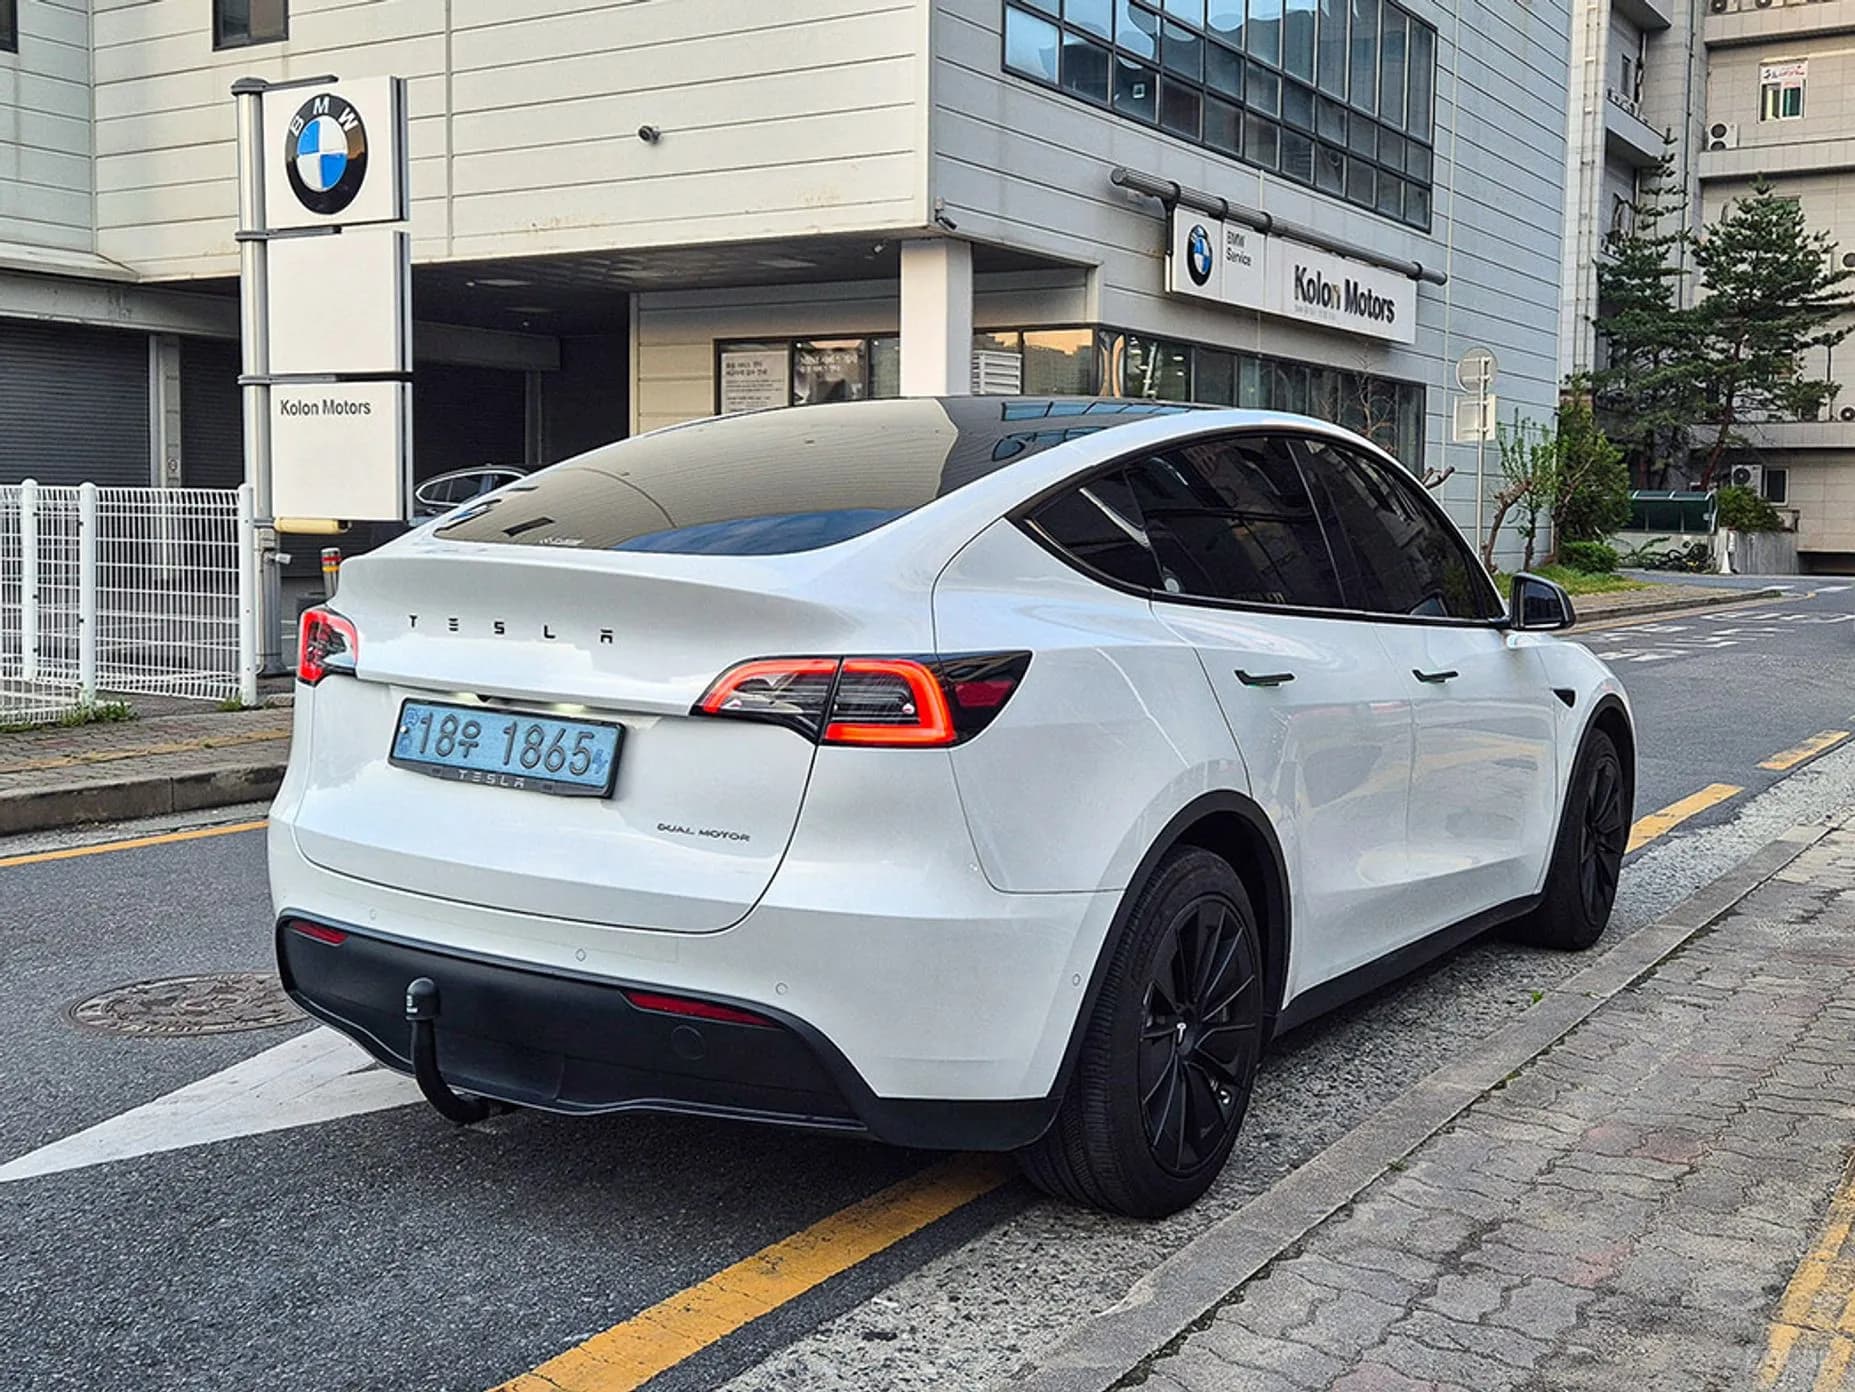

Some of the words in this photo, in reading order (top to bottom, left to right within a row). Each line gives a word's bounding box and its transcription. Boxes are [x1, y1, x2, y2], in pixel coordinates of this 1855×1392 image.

[289, 96, 360, 137] BMW
[1227, 231, 1245, 248] BMW
[1226, 247, 1251, 266] Service
[1294, 264, 1341, 310] Kolon
[1344, 278, 1395, 324] Motors
[280, 399, 320, 416] Kolon
[322, 399, 371, 415] Motors
[409, 615, 613, 644] TESLA
[418, 712, 482, 759] 18우
[503, 721, 595, 777] 1865
[458, 769, 525, 789] TESLA
[657, 822, 695, 835] DUAL
[698, 829, 751, 842] MOTOR
